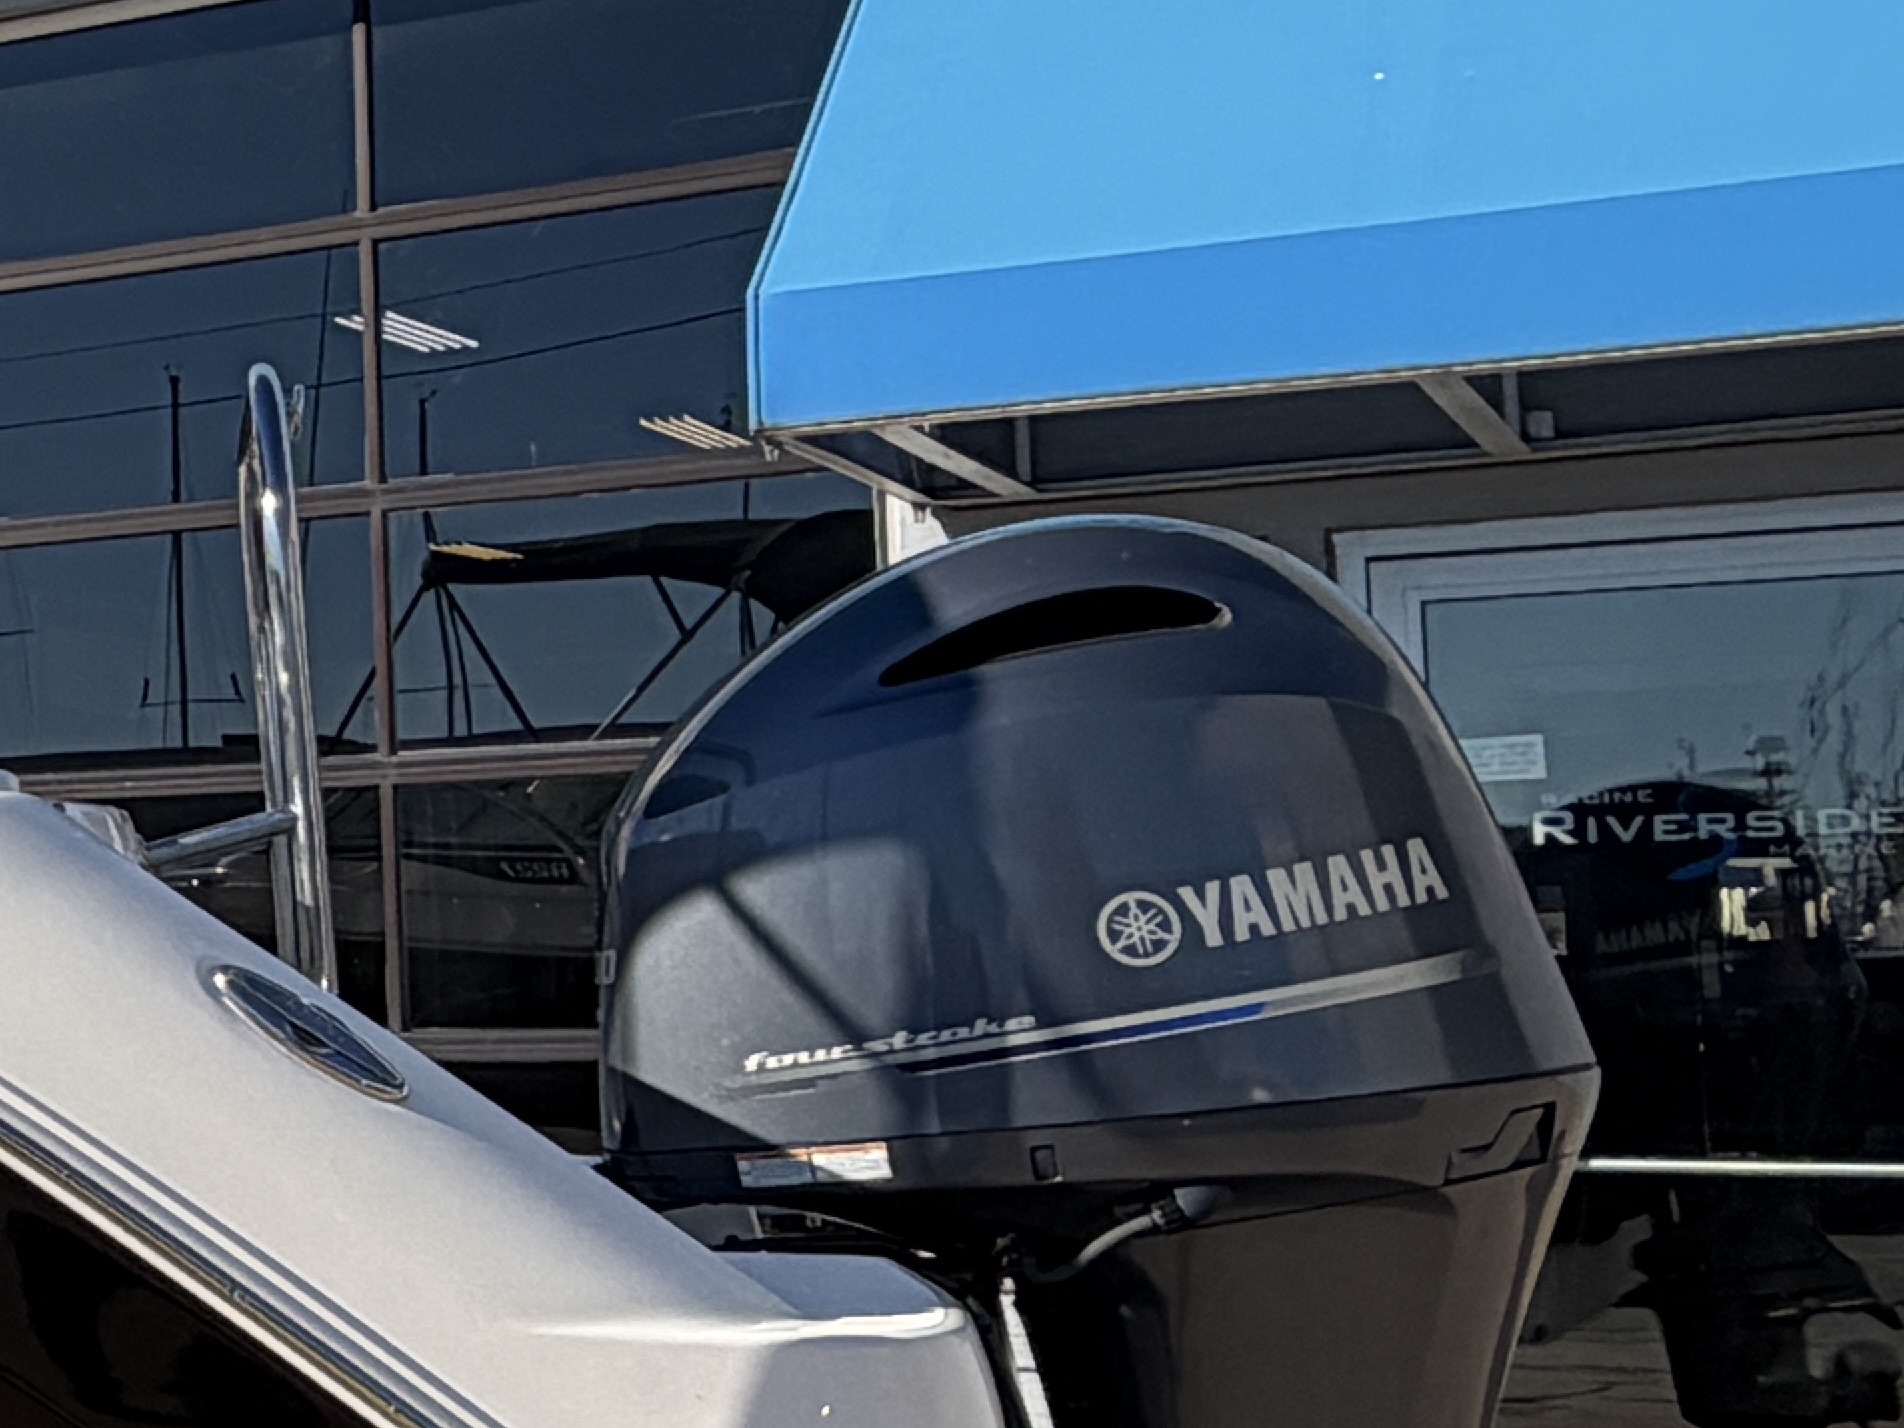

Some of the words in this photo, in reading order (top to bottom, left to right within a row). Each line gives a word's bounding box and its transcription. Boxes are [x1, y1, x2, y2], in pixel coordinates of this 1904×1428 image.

[1532, 807, 1904, 846] RIVERSIDE
[1178, 836, 1450, 949] YAMAHA
[743, 1045, 854, 1072] four
[862, 1014, 1037, 1054] stroke
